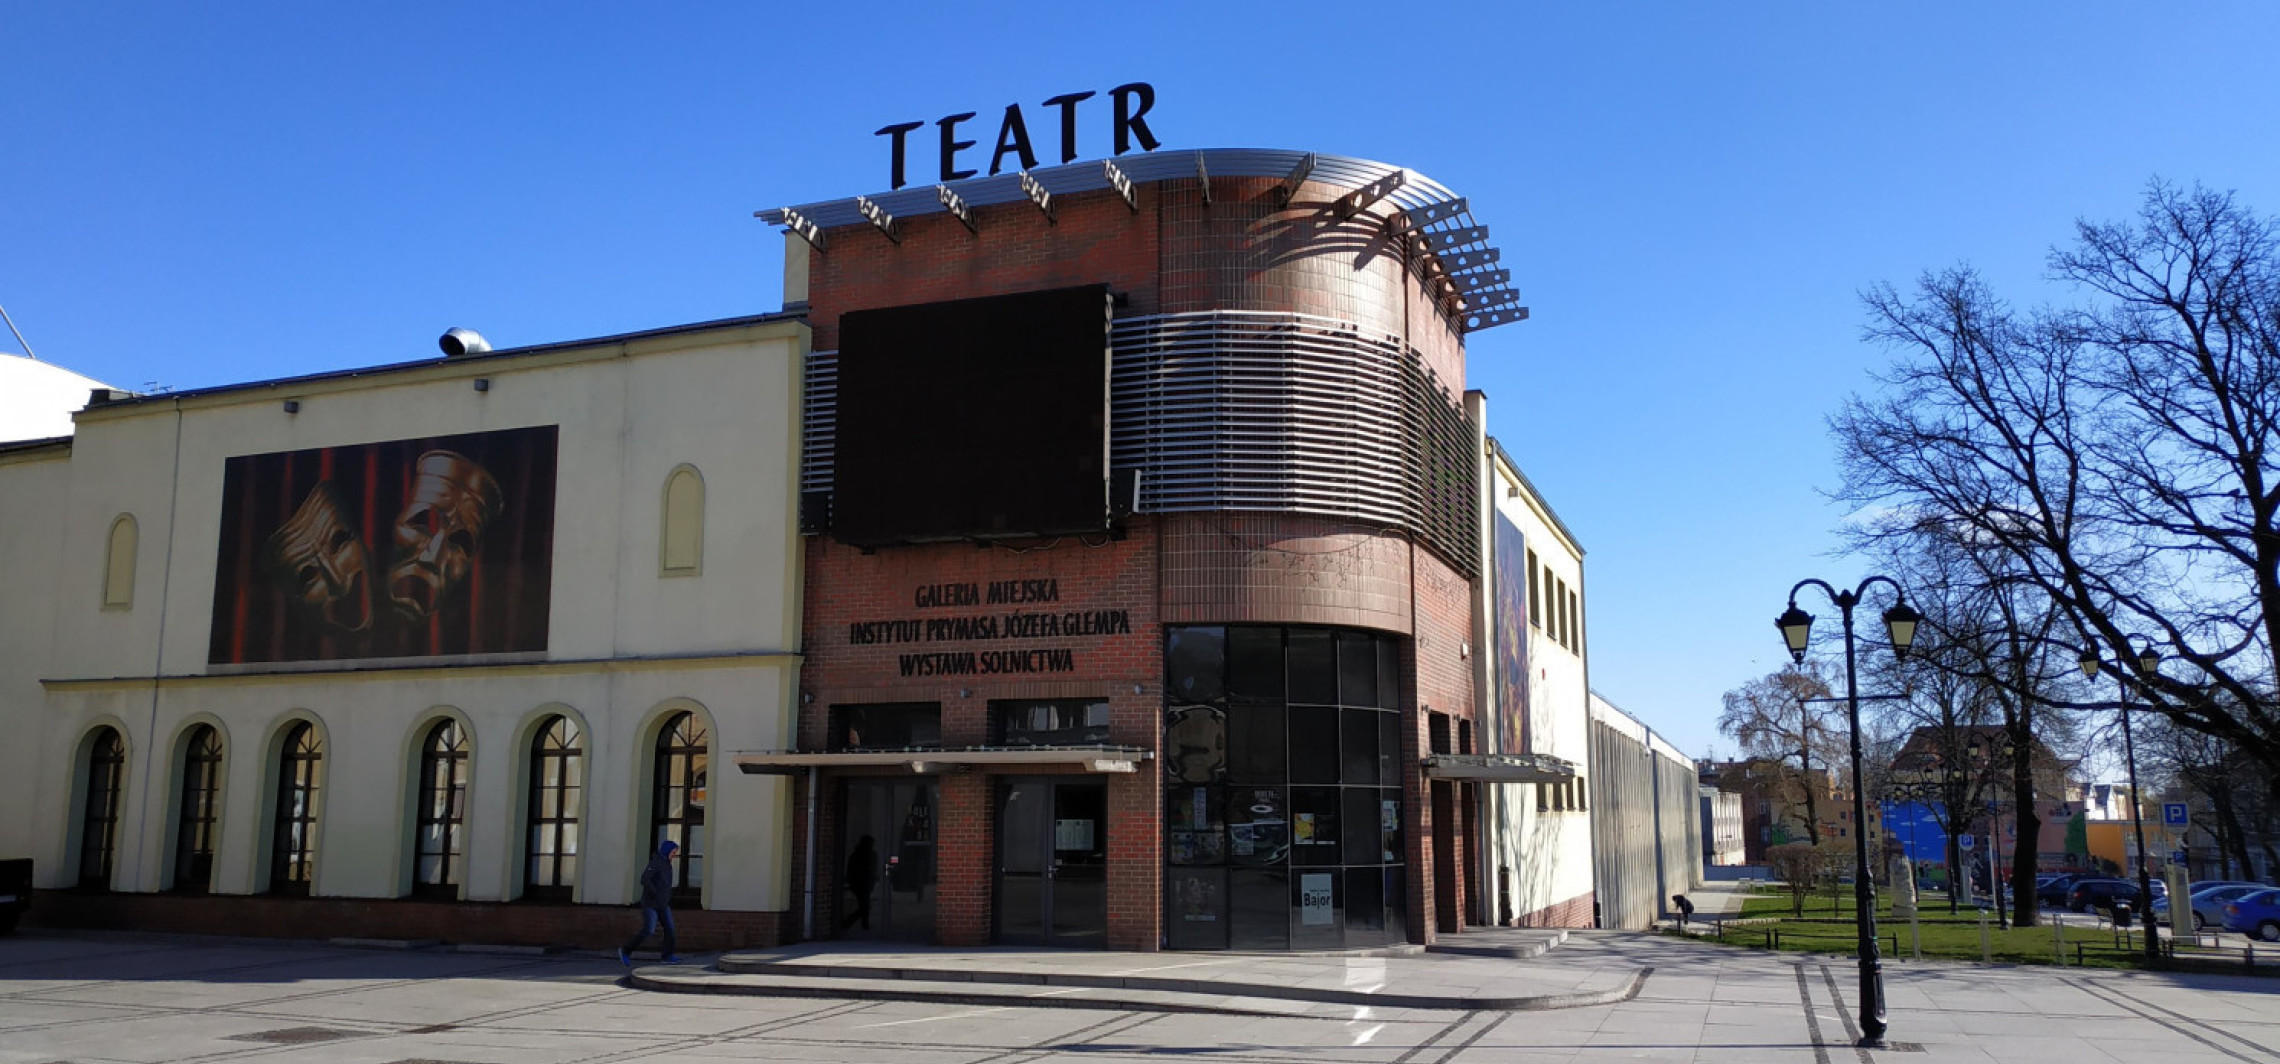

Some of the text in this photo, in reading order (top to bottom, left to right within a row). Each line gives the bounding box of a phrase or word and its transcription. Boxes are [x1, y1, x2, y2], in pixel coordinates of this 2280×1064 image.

[874, 82, 1161, 190] TEATR
[915, 579, 1059, 608] GALERIA MIEJSKA
[850, 608, 1130, 645] INSTYTUT PRYMASA JÓZEFA GLEMPA
[899, 649, 1074, 677] WYSTAWA SOLNICTWA
[2170, 806, 2182, 821] P
[1304, 892, 1331, 909] Bajor
